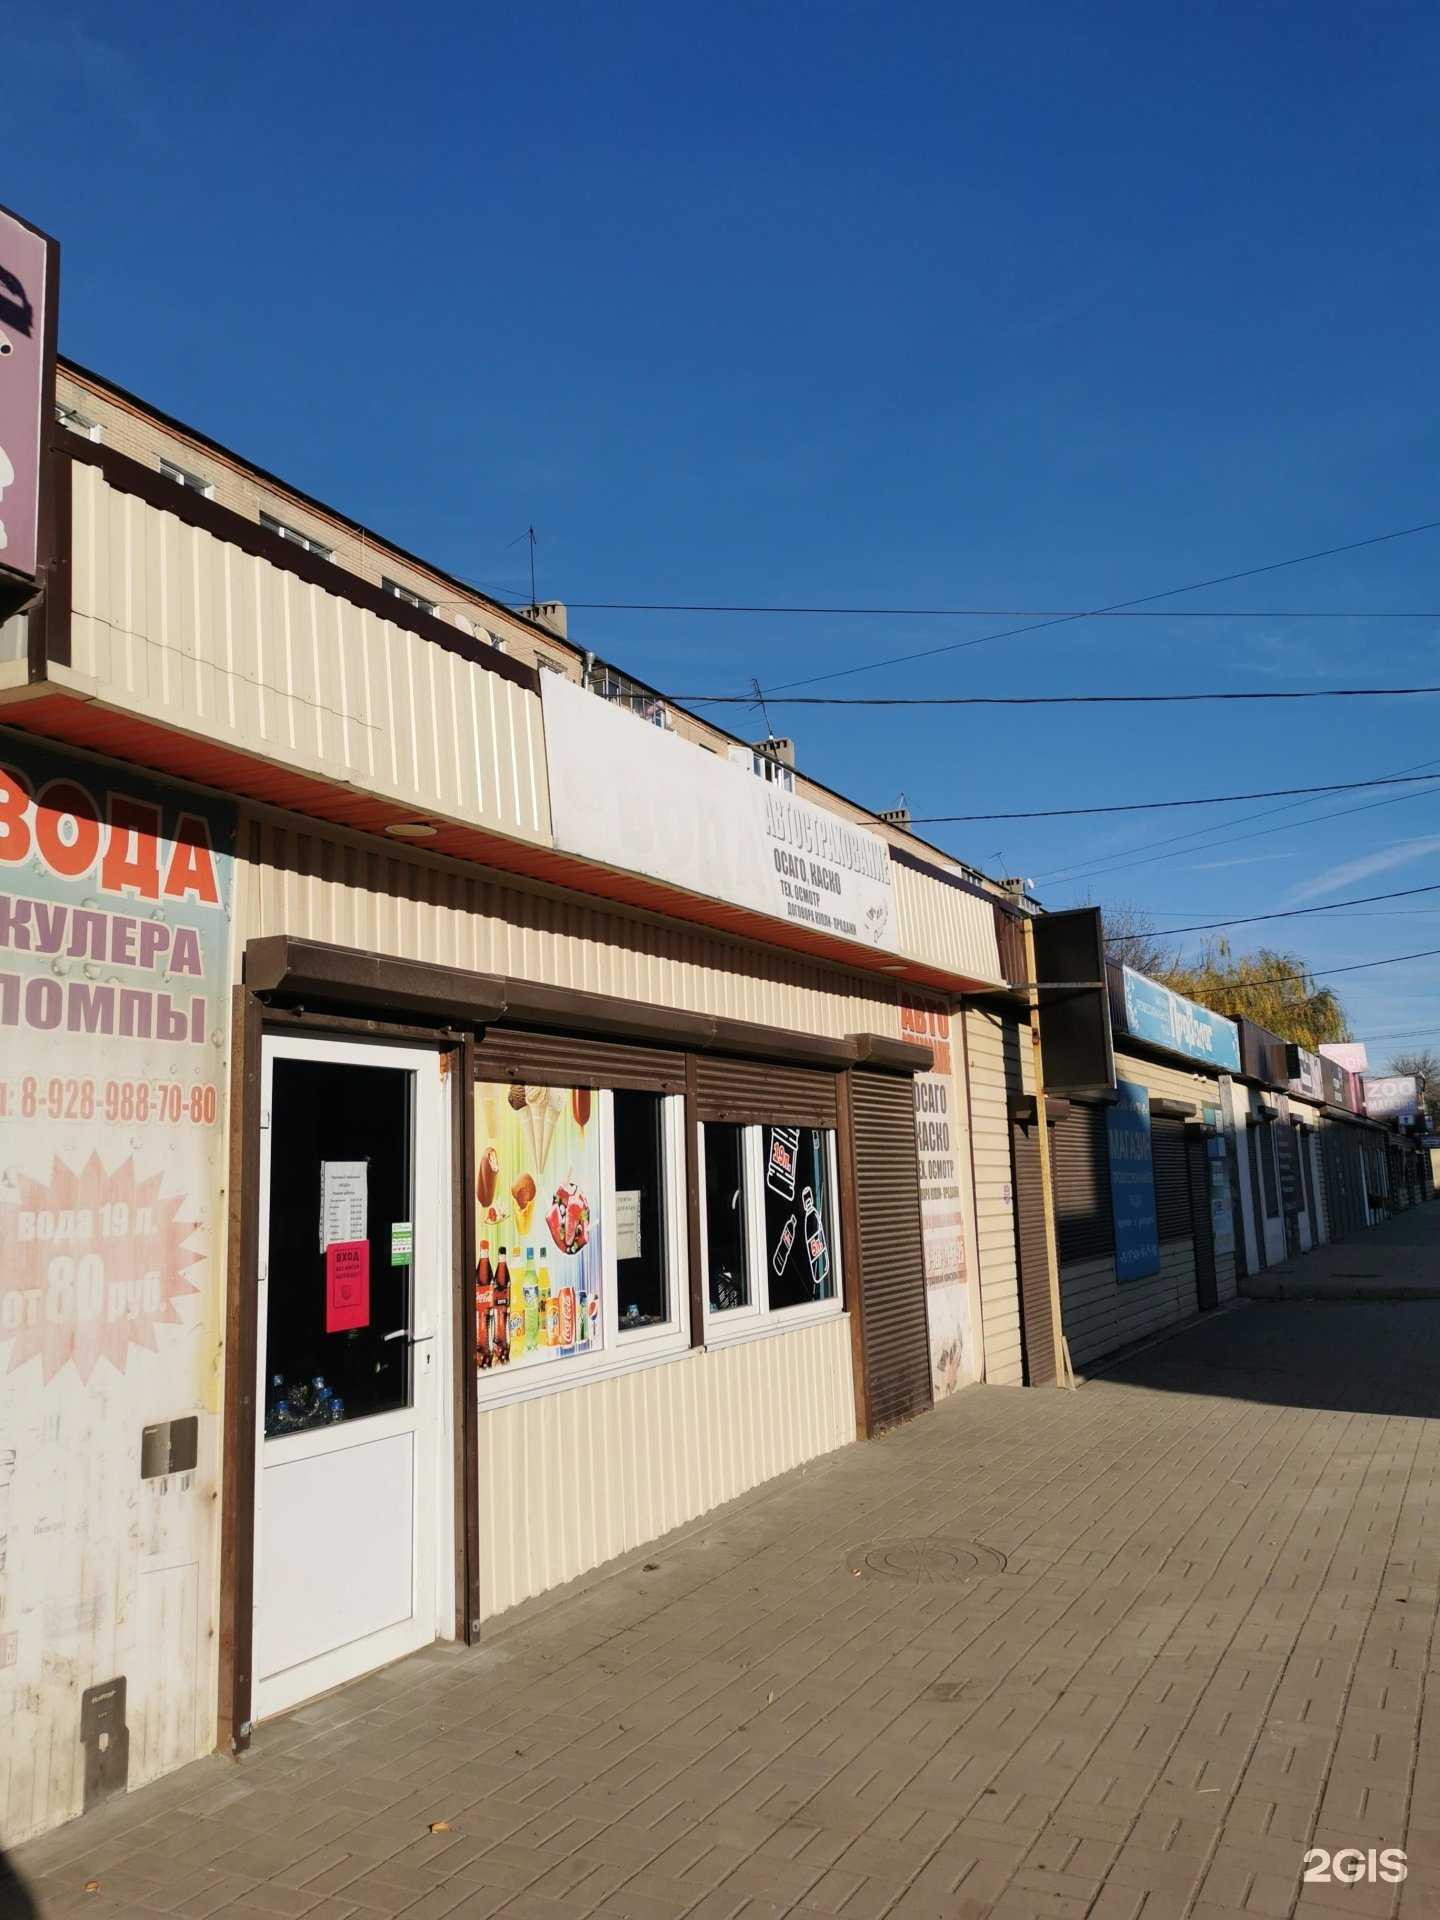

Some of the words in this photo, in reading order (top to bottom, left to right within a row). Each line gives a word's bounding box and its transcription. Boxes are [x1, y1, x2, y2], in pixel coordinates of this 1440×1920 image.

[0, 762, 220, 905] ВОДА
[794, 884, 820, 907] ОСМОТР
[809, 861, 842, 895] КАСКО
[0, 895, 202, 976] КУЛЕРА
[21, 1076, 217, 1124] 8-928-988-70-80
[99, 1201, 129, 1236] 19
[47, 1254, 105, 1324] 80
